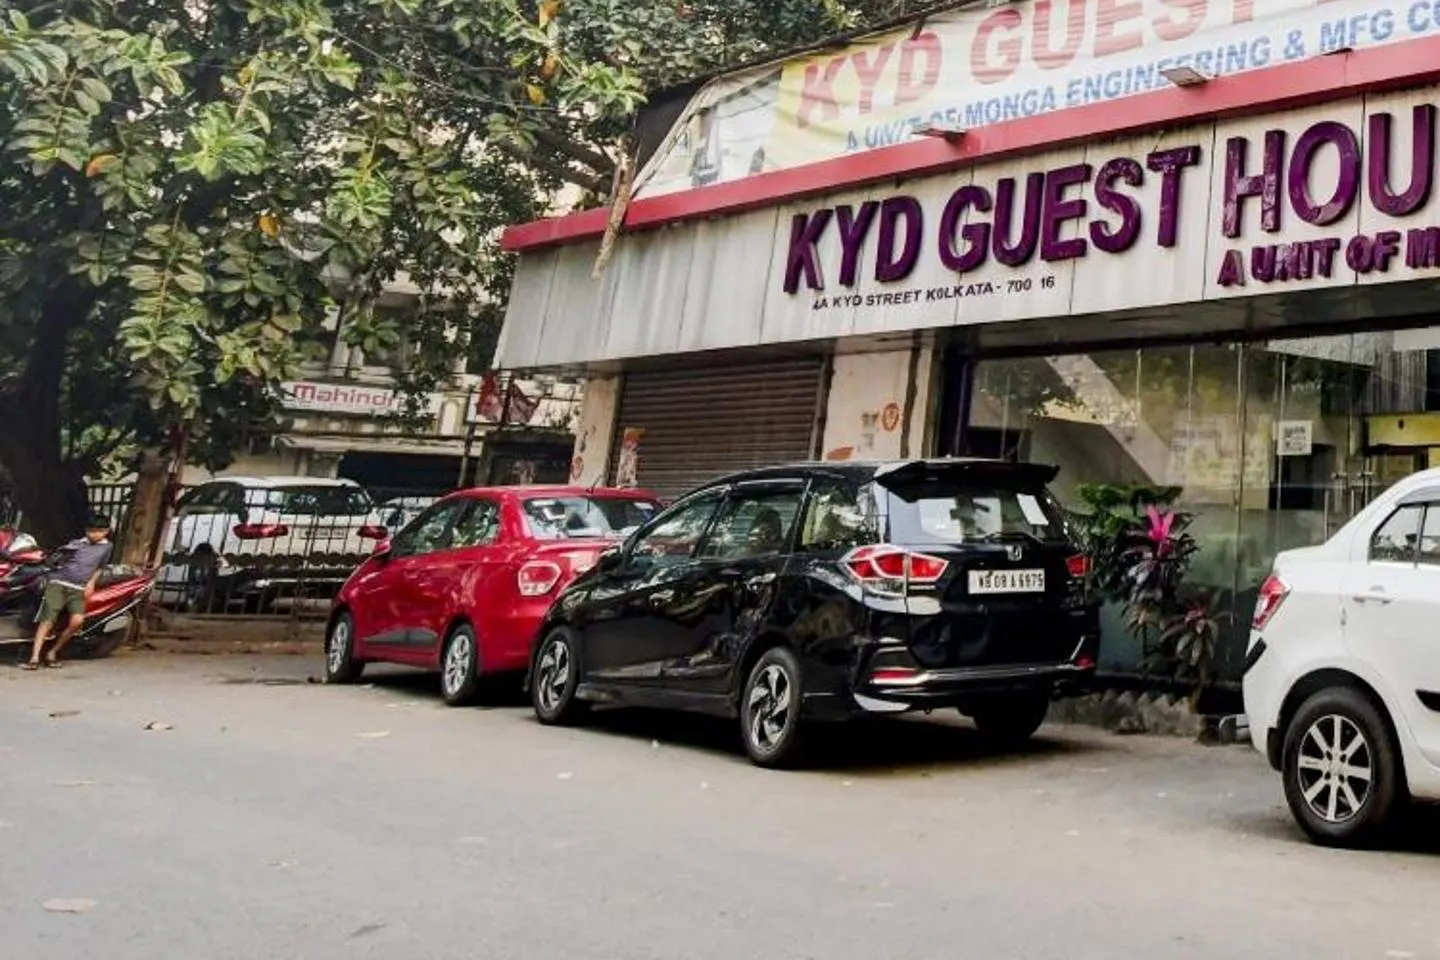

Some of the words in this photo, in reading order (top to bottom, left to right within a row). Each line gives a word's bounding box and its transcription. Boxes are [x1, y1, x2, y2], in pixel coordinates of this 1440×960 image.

[798, 30, 942, 126] KYD
[846, 129, 859, 152] A
[965, 86, 1057, 126] MONGA
[1282, 28, 1306, 59] &
[1320, 8, 1394, 53] MFG
[783, 195, 924, 295] KYD
[937, 145, 1201, 276] GUEST
[1217, 247, 1246, 288] A
[1250, 237, 1340, 284] UNIT
[1345, 229, 1400, 274] OF
[833, 293, 863, 308] KYD
[866, 290, 921, 307] STREET
[1007, 279, 1032, 294] 700
